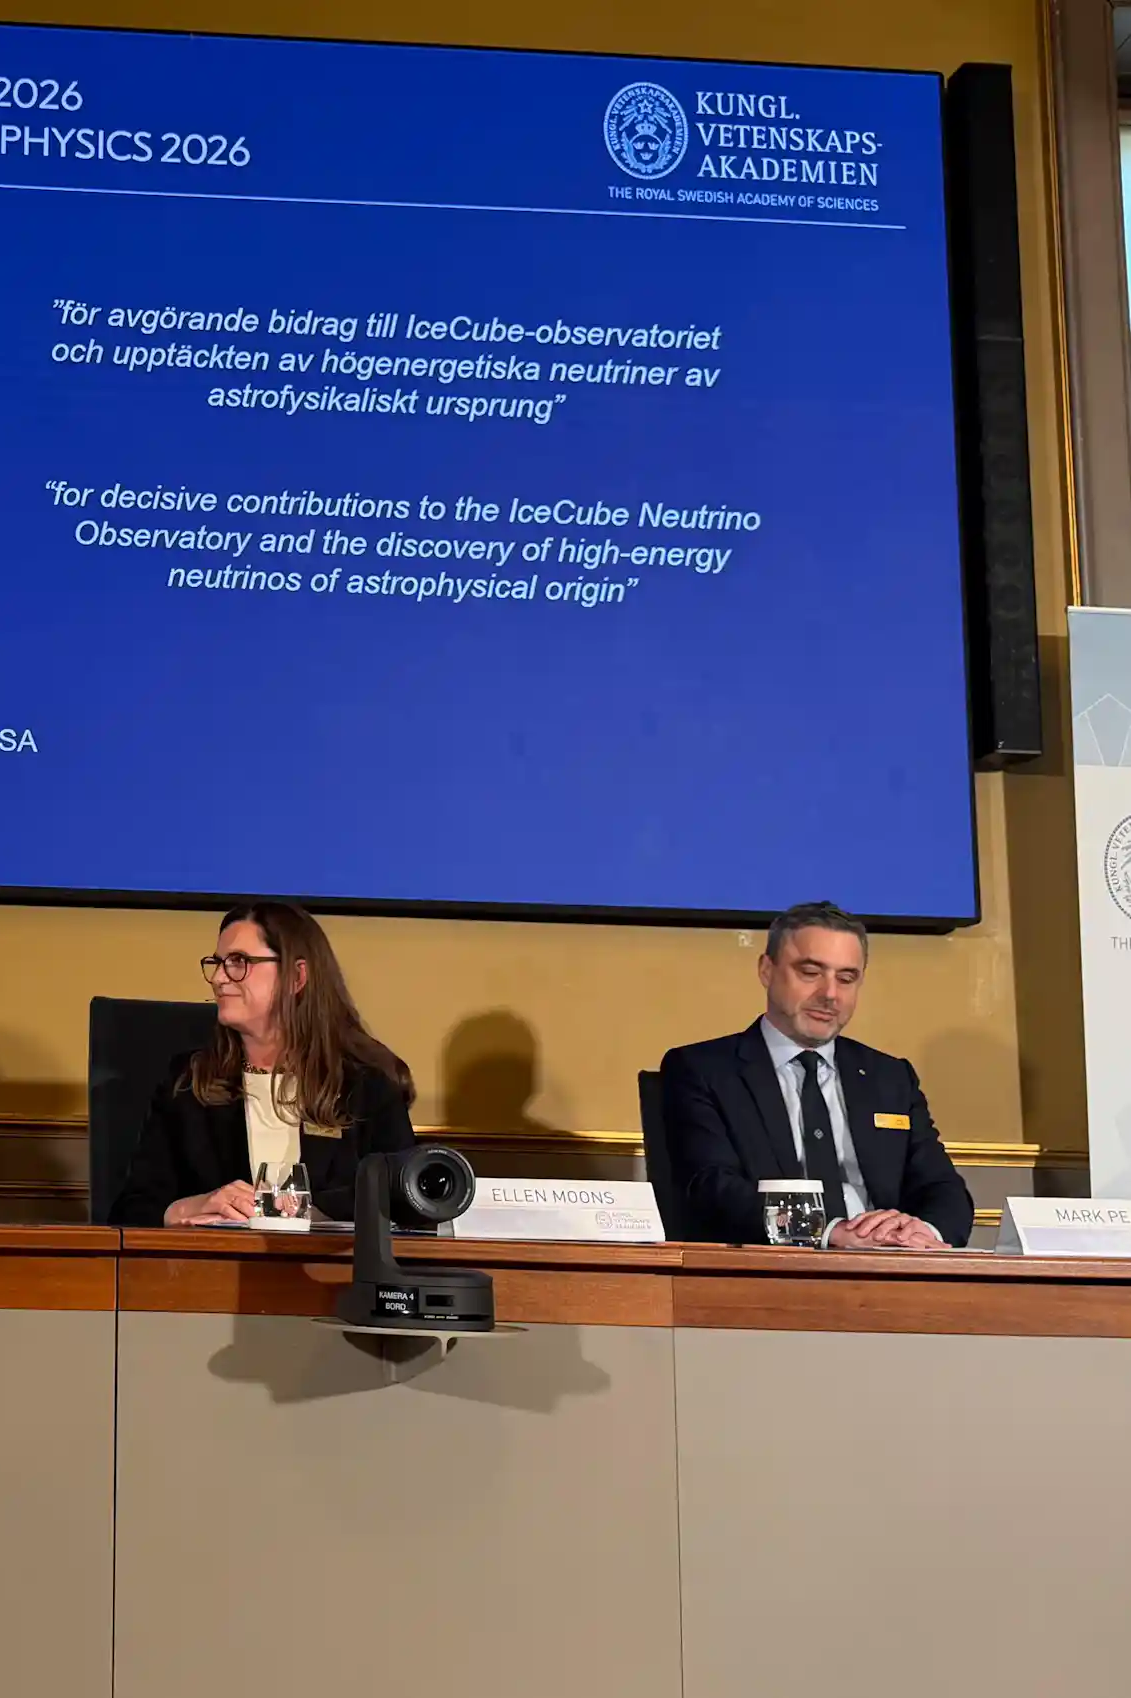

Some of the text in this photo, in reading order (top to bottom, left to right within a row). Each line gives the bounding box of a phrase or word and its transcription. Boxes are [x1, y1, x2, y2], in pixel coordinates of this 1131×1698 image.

[696, 91, 800, 120] KUNGL.
[1, 125, 153, 162] PHYSICS
[160, 133, 251, 167] 2026
[695, 122, 883, 156] VETENSKAPS-
[697, 155, 878, 187] AKADEMIEN
[608, 186, 880, 212] THE ROYAL SWEDISH ACADEMY OF SCIENCES
[107, 307, 259, 335] avgörande
[268, 308, 358, 343] bidrag
[366, 313, 399, 339] till
[406, 314, 721, 351] IceCube-observatoriet
[52, 339, 721, 388] och upptäckten av högenergetiska neutriner av
[207, 383, 567, 425] astrofysikaliskt ursprung”
[100, 483, 218, 513] decisive
[226, 488, 410, 520] contributions
[419, 495, 446, 521] to
[455, 496, 500, 523] the
[509, 497, 630, 527] IceCube
[638, 501, 762, 532] Neutrino
[74, 519, 733, 574] Observatory and the discovery of high-energy
[167, 564, 640, 608] neutrinos of astrophysical origin”
[492, 1188, 615, 1205] ELLEN MOONS
[1055, 1208, 1106, 1224] MARK
[379, 1291, 408, 1300] KAMERA
[385, 1303, 406, 1311] BORD
